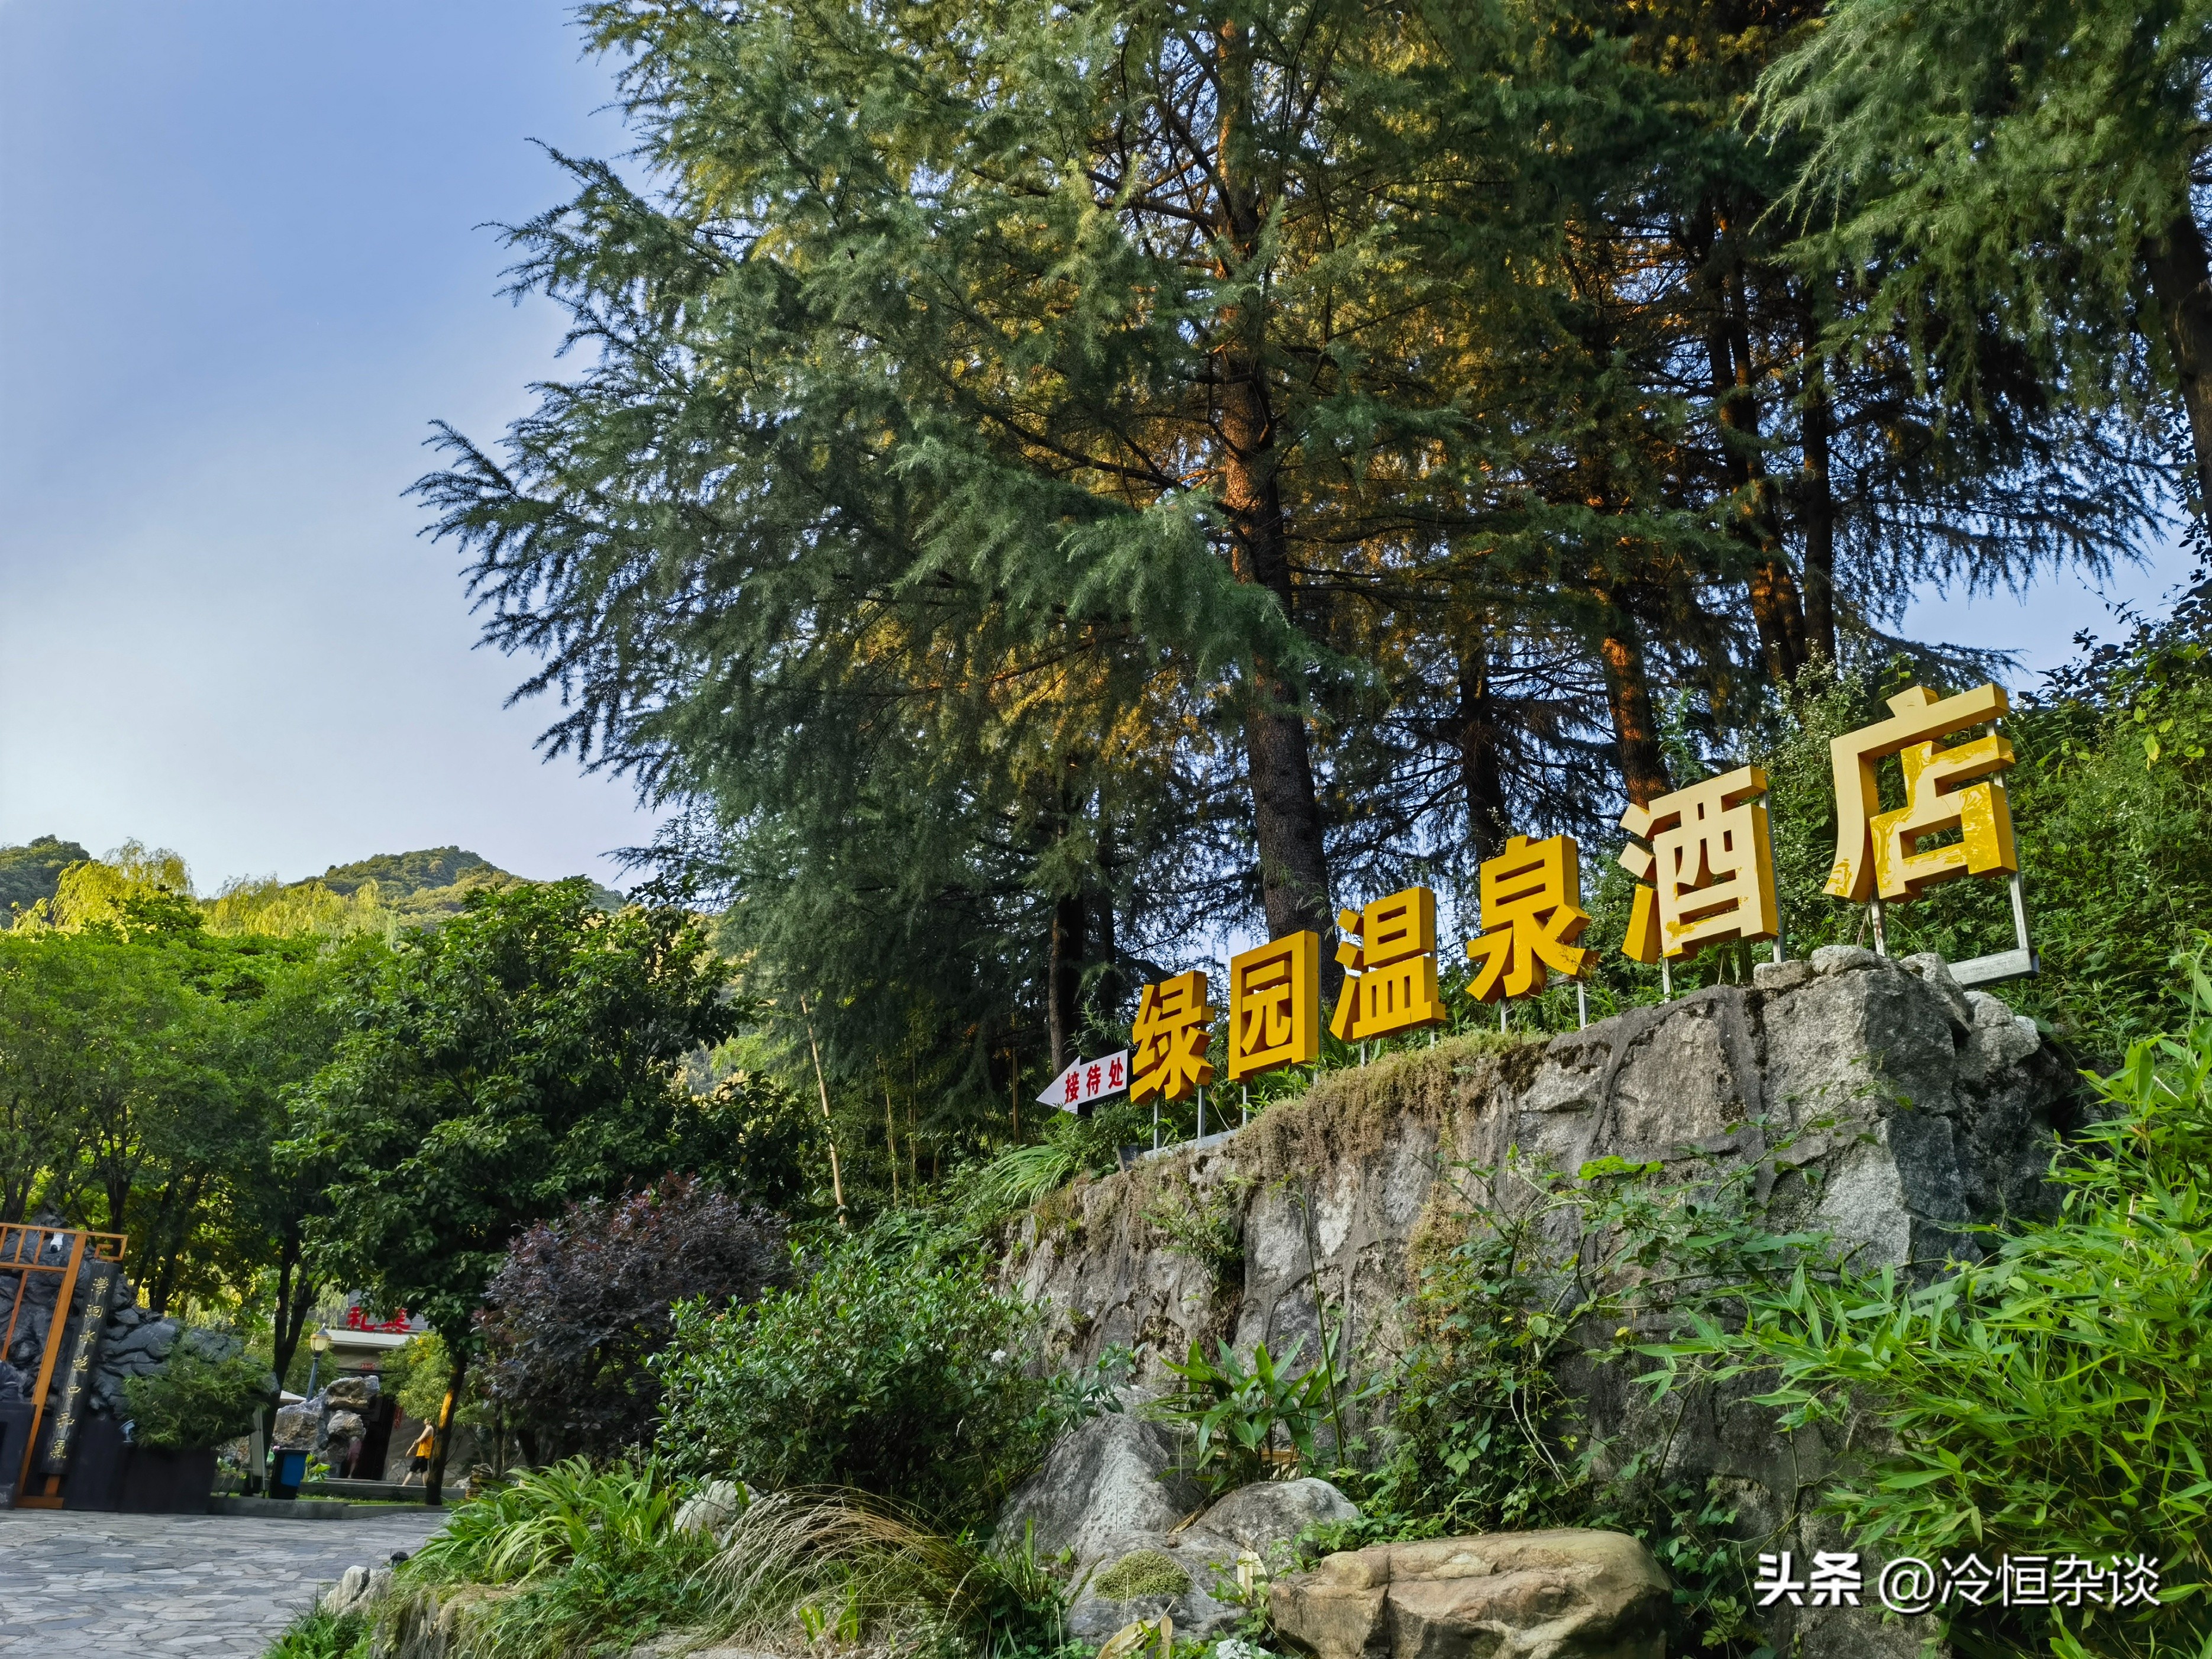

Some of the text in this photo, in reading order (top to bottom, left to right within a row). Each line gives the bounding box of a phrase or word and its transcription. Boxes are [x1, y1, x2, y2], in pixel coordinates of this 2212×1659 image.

[1130, 682, 2016, 1104] 绿园温泉酒店
[1065, 1057, 1124, 1104] 接待处
